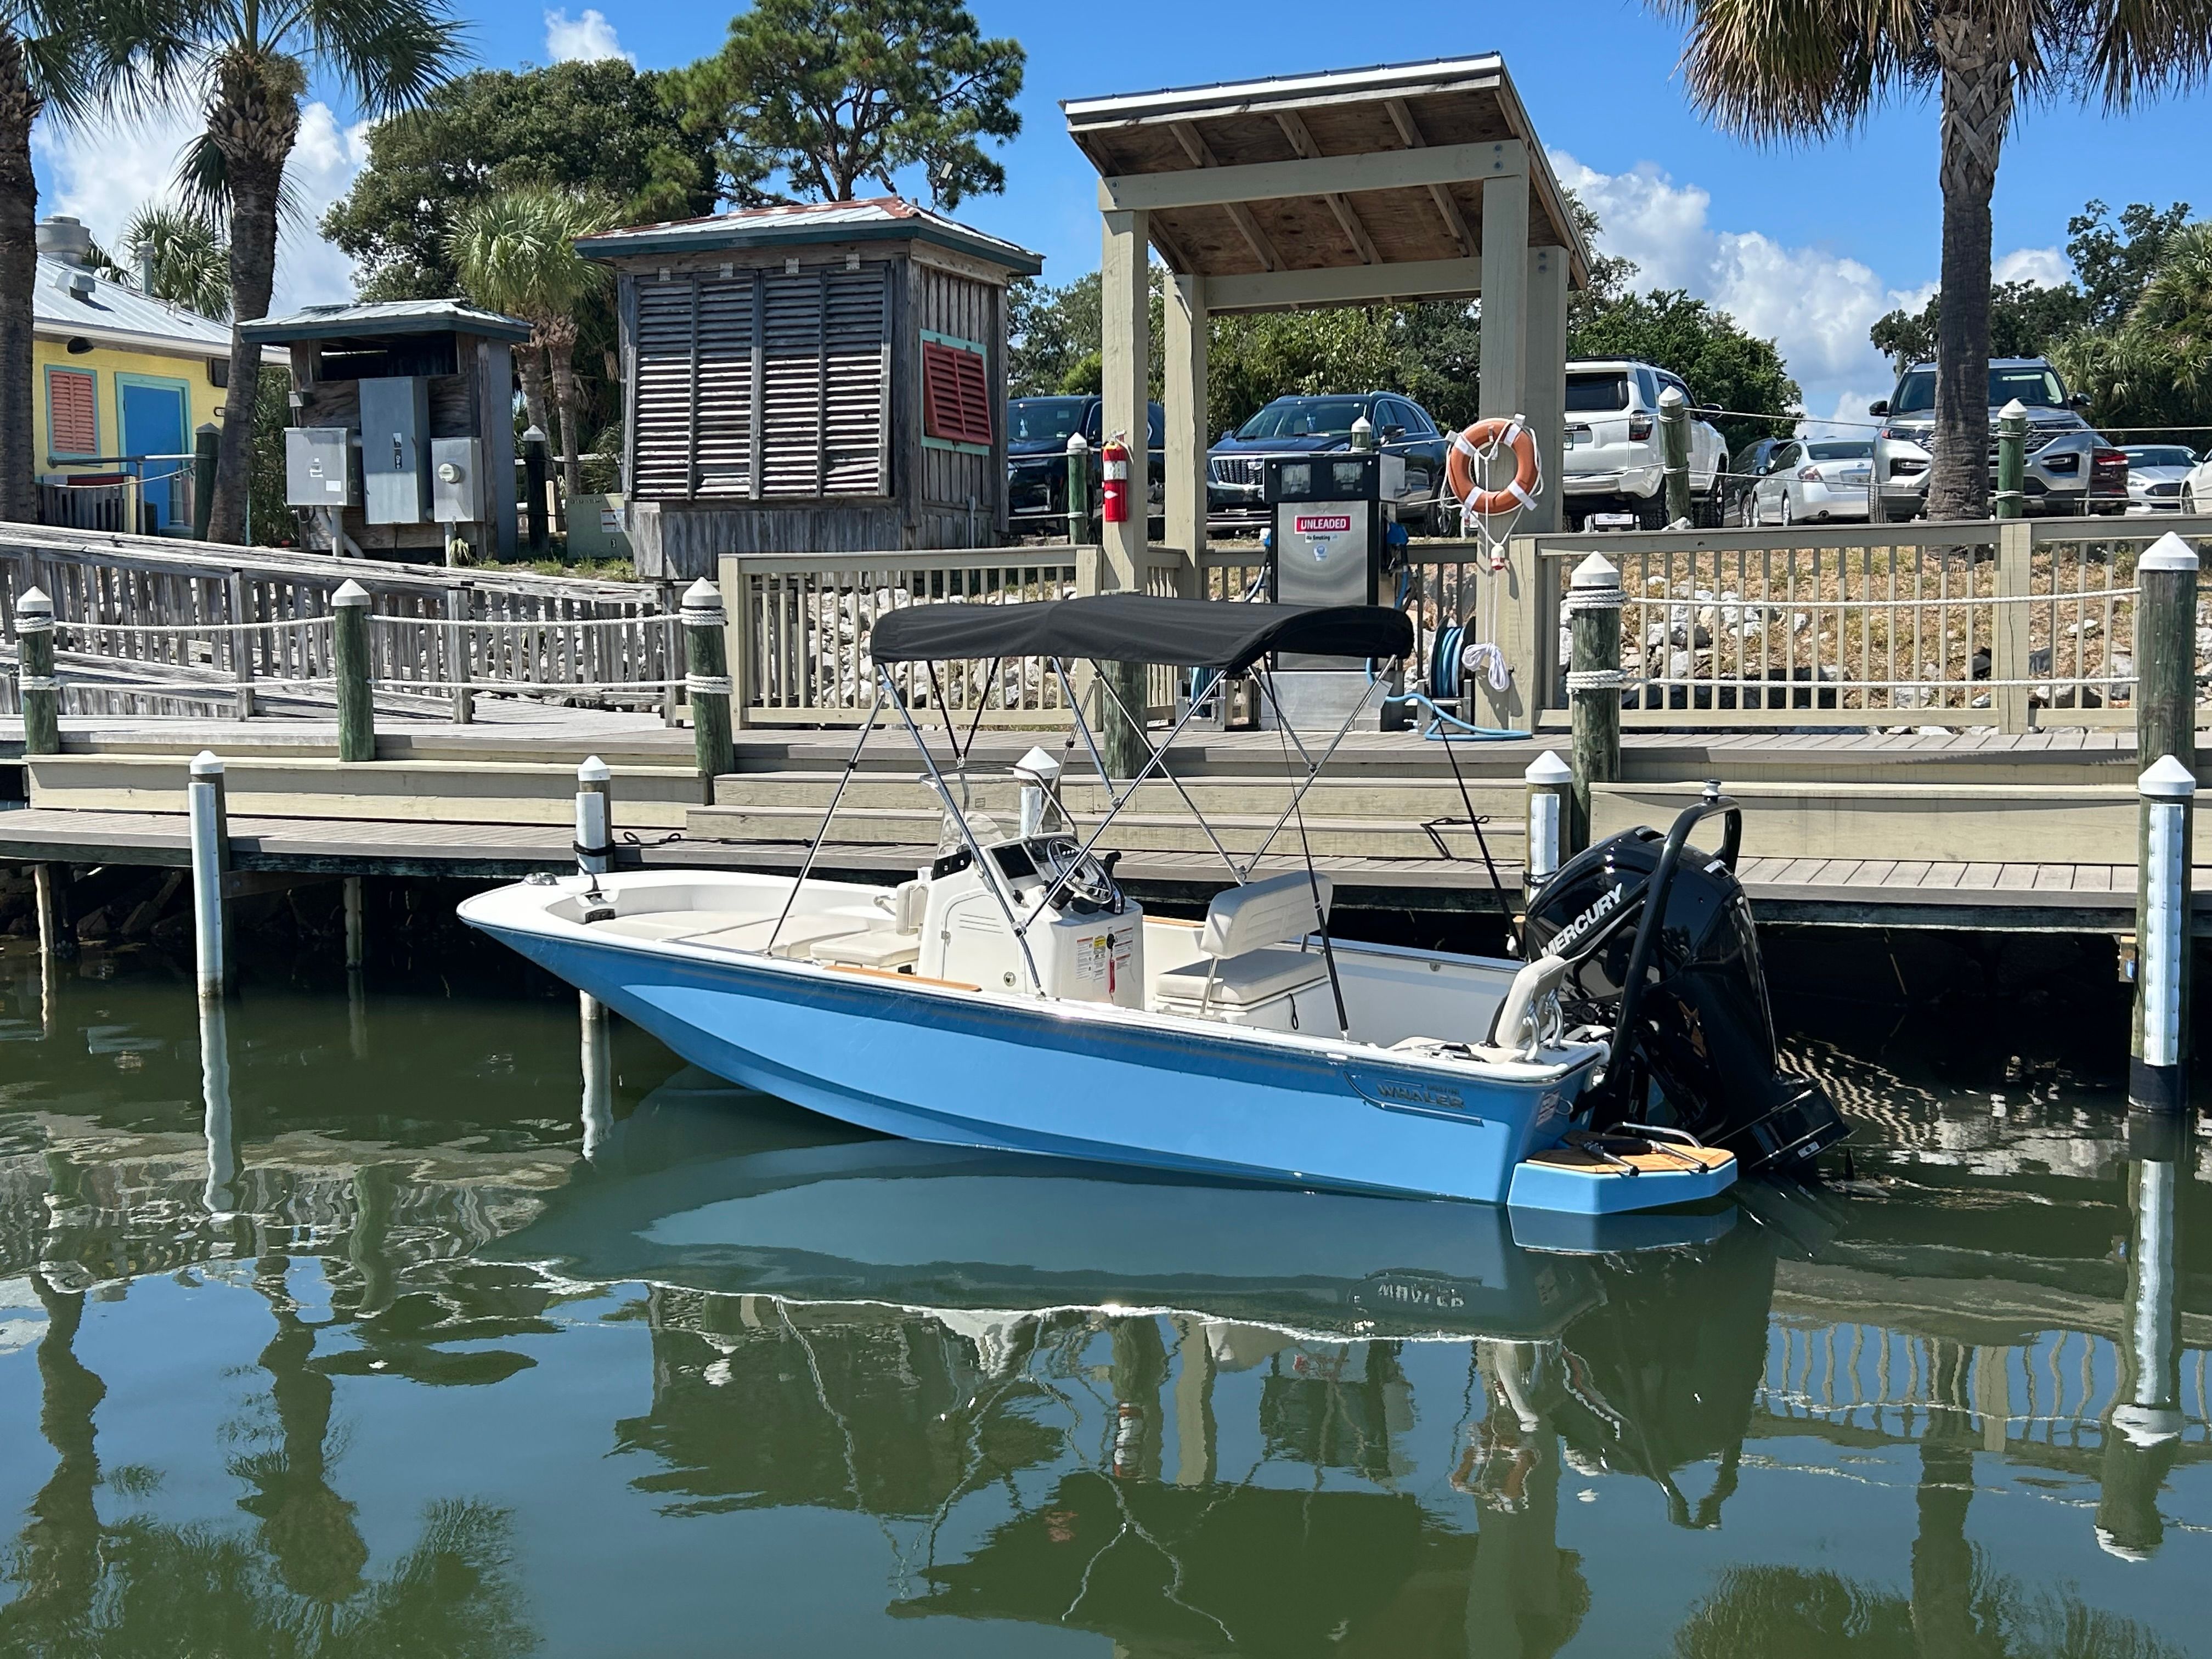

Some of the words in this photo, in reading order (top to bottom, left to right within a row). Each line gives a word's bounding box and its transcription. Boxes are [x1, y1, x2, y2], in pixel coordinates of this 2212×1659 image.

[1301, 518, 1346, 530] UNLEADED
[611, 539, 616, 548] 3
[1541, 883, 1622, 958] MERCURY
[1377, 1084, 1465, 1109] WHALER
